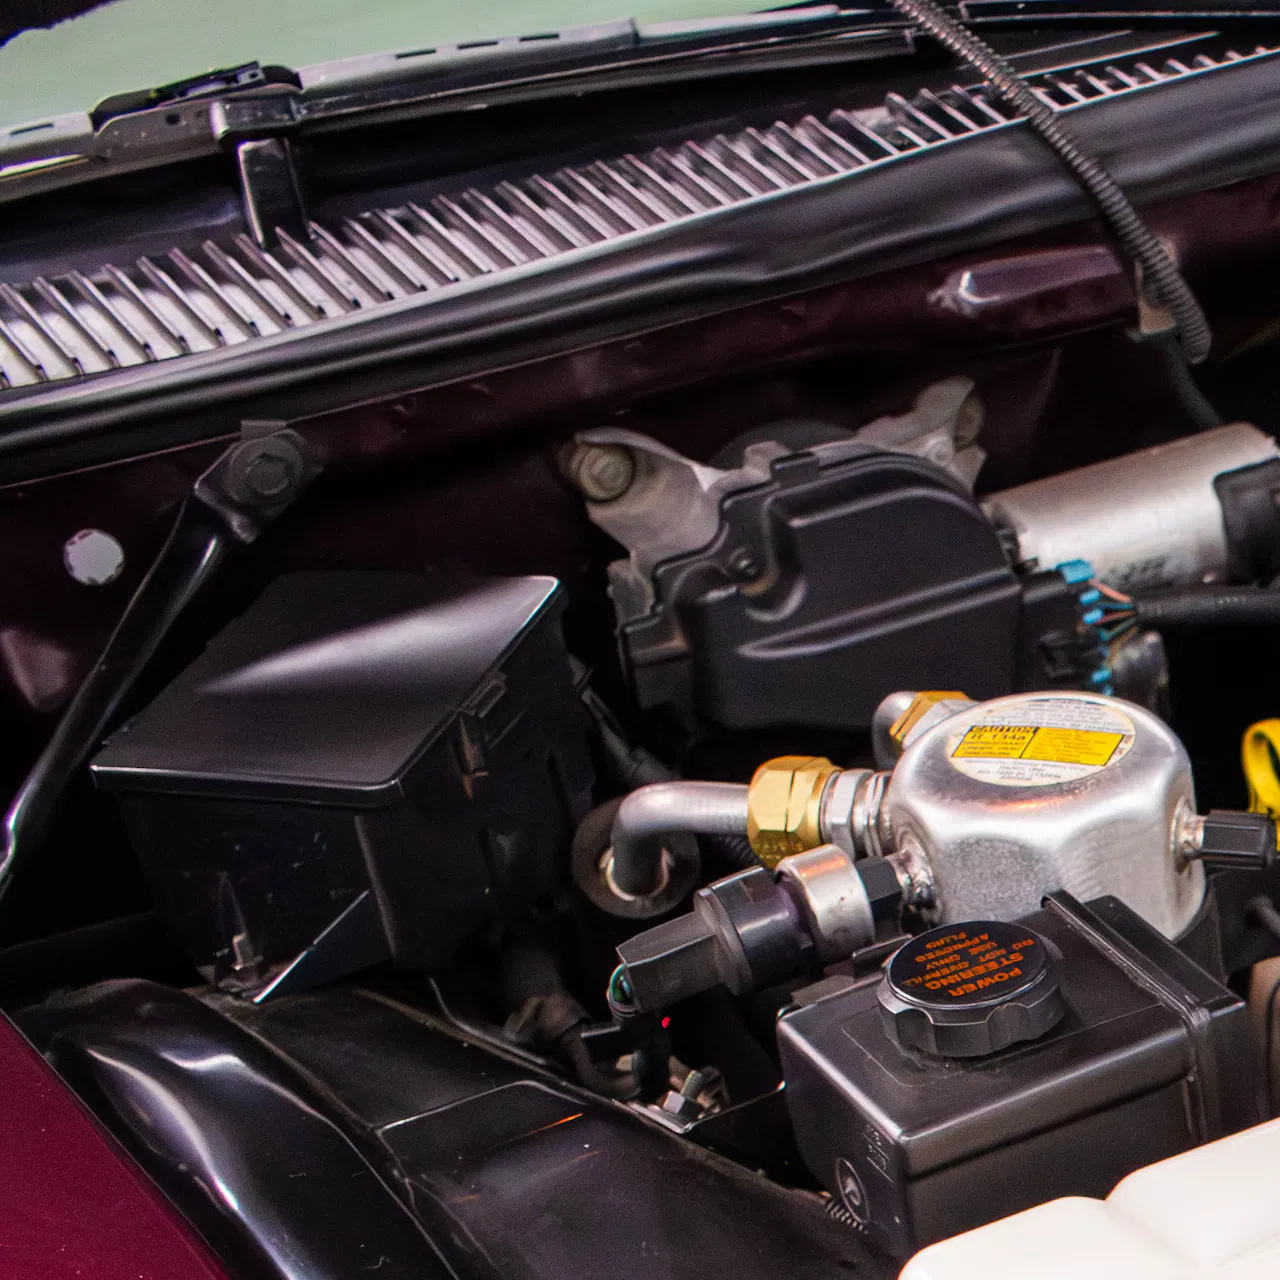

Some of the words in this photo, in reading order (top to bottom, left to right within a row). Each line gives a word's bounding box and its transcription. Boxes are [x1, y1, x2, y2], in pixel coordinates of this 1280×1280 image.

[915, 933, 988, 963] APPROVED
[926, 932, 966, 949] FLUID
[968, 941, 998, 955] USE
[1012, 939, 1034, 950] DO
[926, 954, 961, 970] ONLY
[978, 948, 1007, 962] NOT
[925, 952, 1024, 990] STEERING
[948, 967, 1022, 997] POWER
